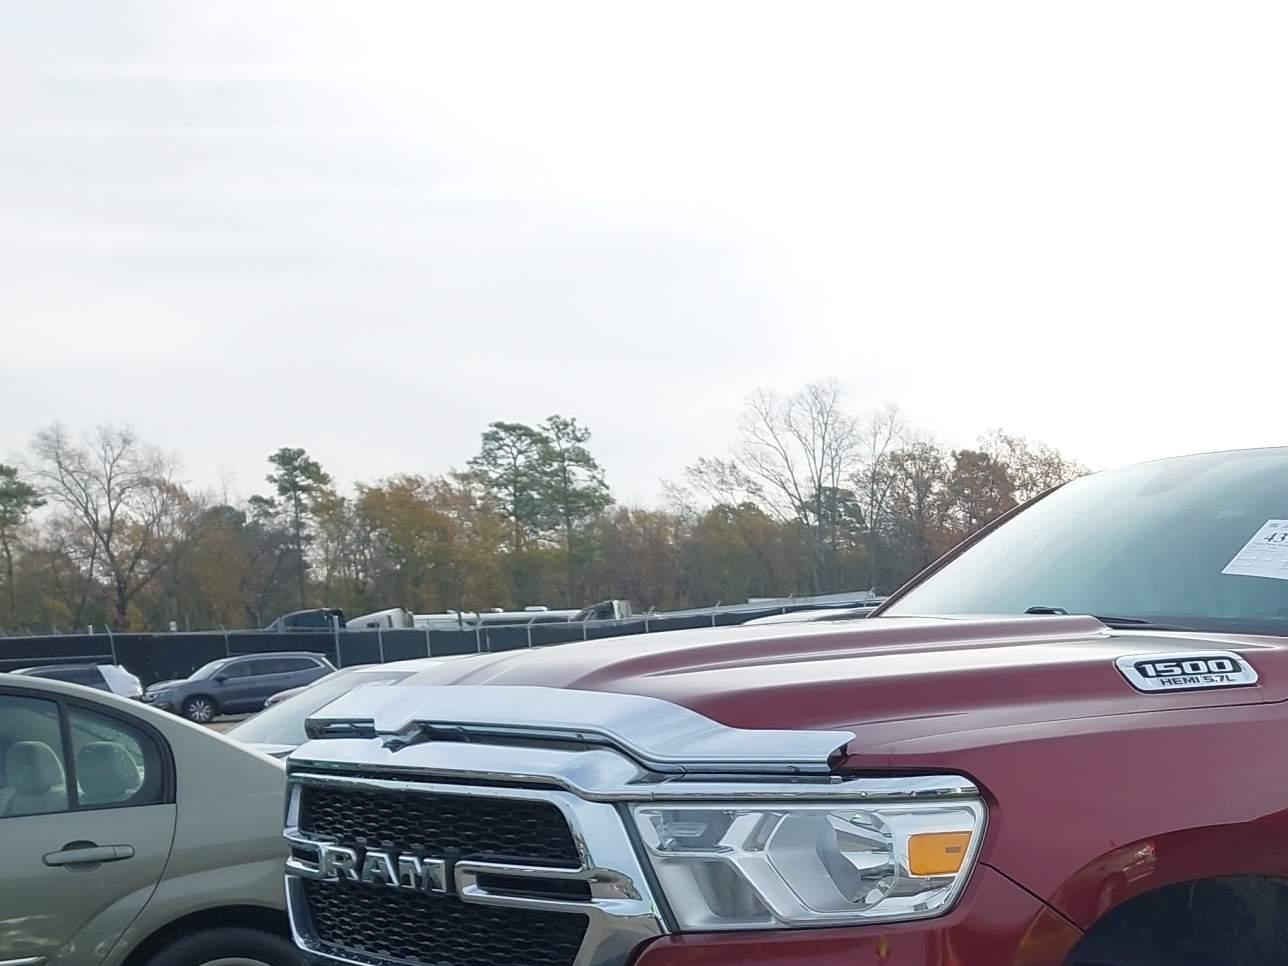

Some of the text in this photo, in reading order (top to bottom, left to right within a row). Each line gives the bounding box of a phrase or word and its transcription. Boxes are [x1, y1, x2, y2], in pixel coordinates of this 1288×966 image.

[1139, 659, 1234, 677] 1500
[1160, 674, 1236, 686] HEMI 5.7L
[322, 845, 447, 893] RAM
